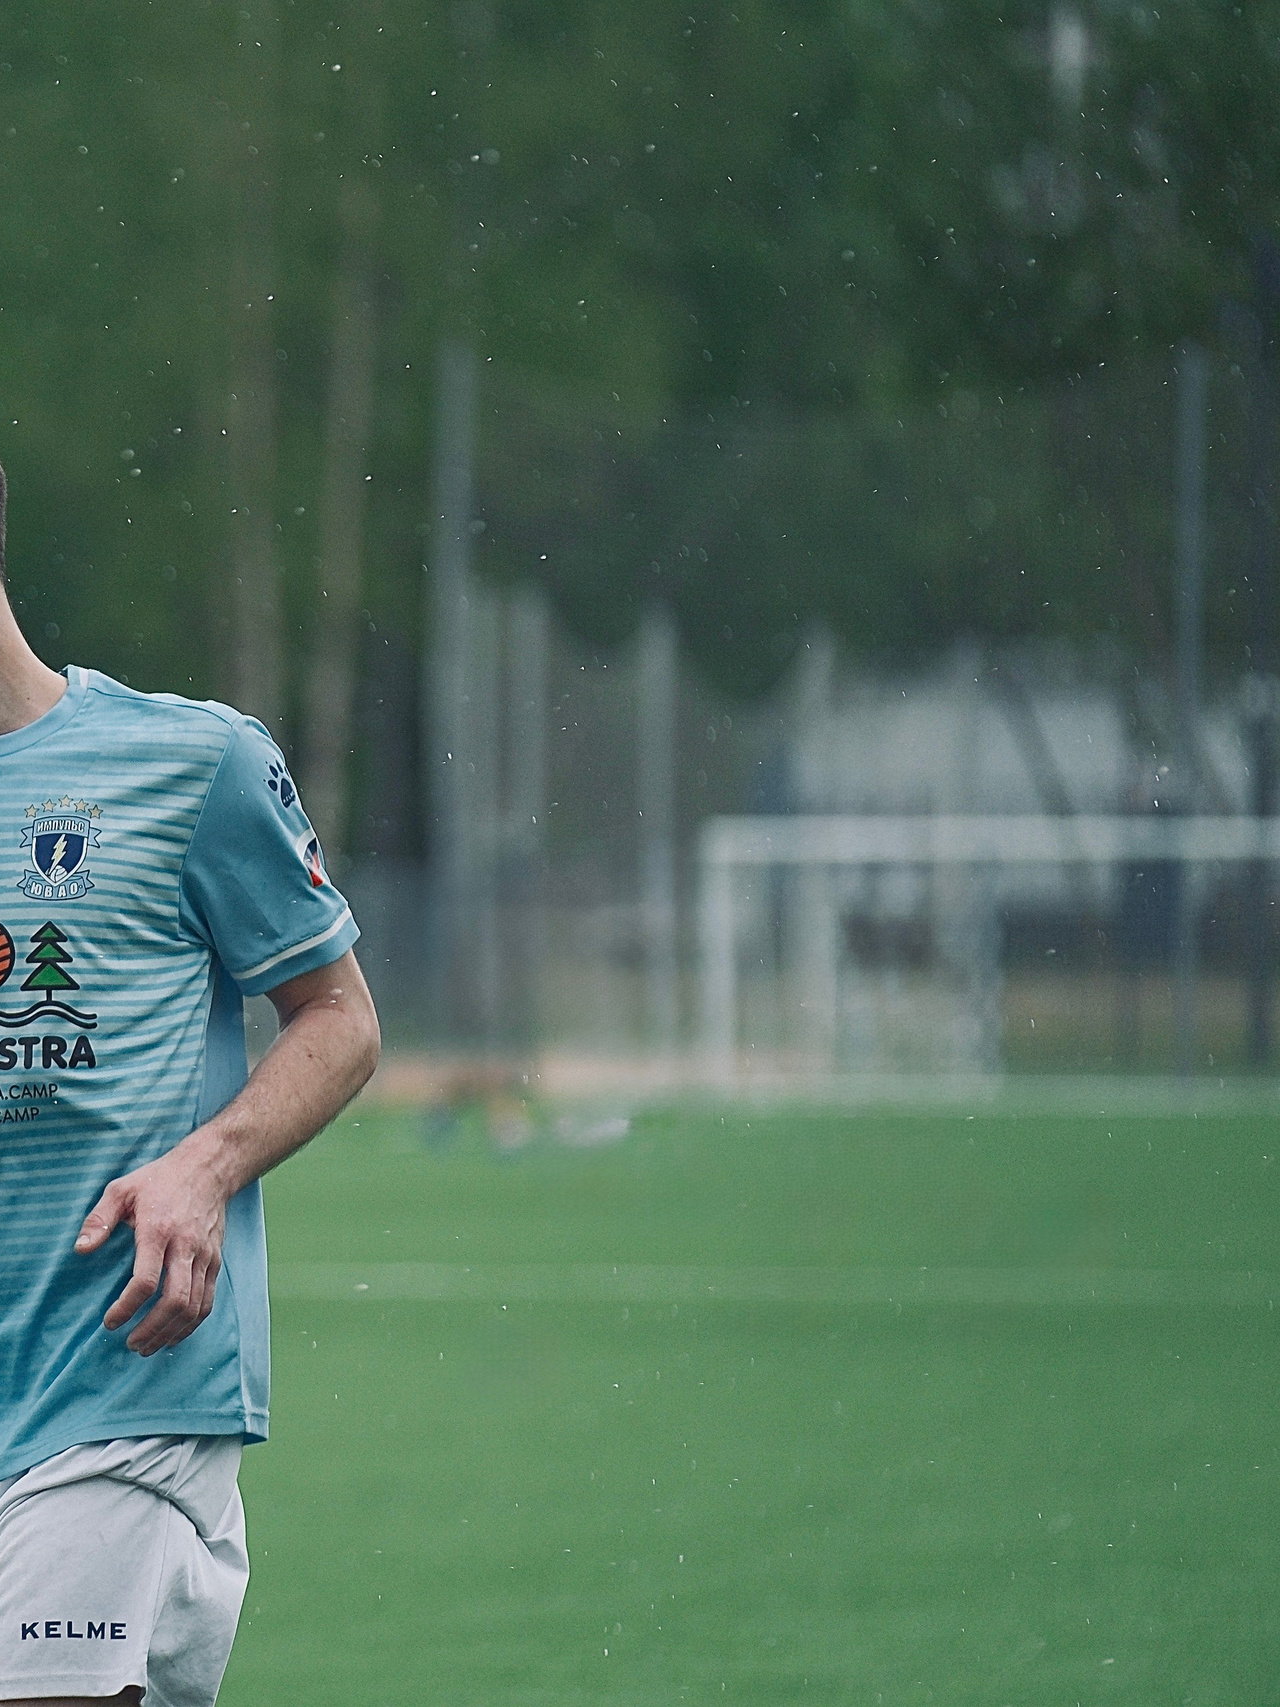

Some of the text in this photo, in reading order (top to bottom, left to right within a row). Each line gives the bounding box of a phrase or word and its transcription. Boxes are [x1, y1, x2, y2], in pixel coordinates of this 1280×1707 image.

[37, 819, 86, 833] ИМПУЛЬС
[30, 882, 79, 898] ЮВАО
[21, 1621, 126, 1639] KELME
